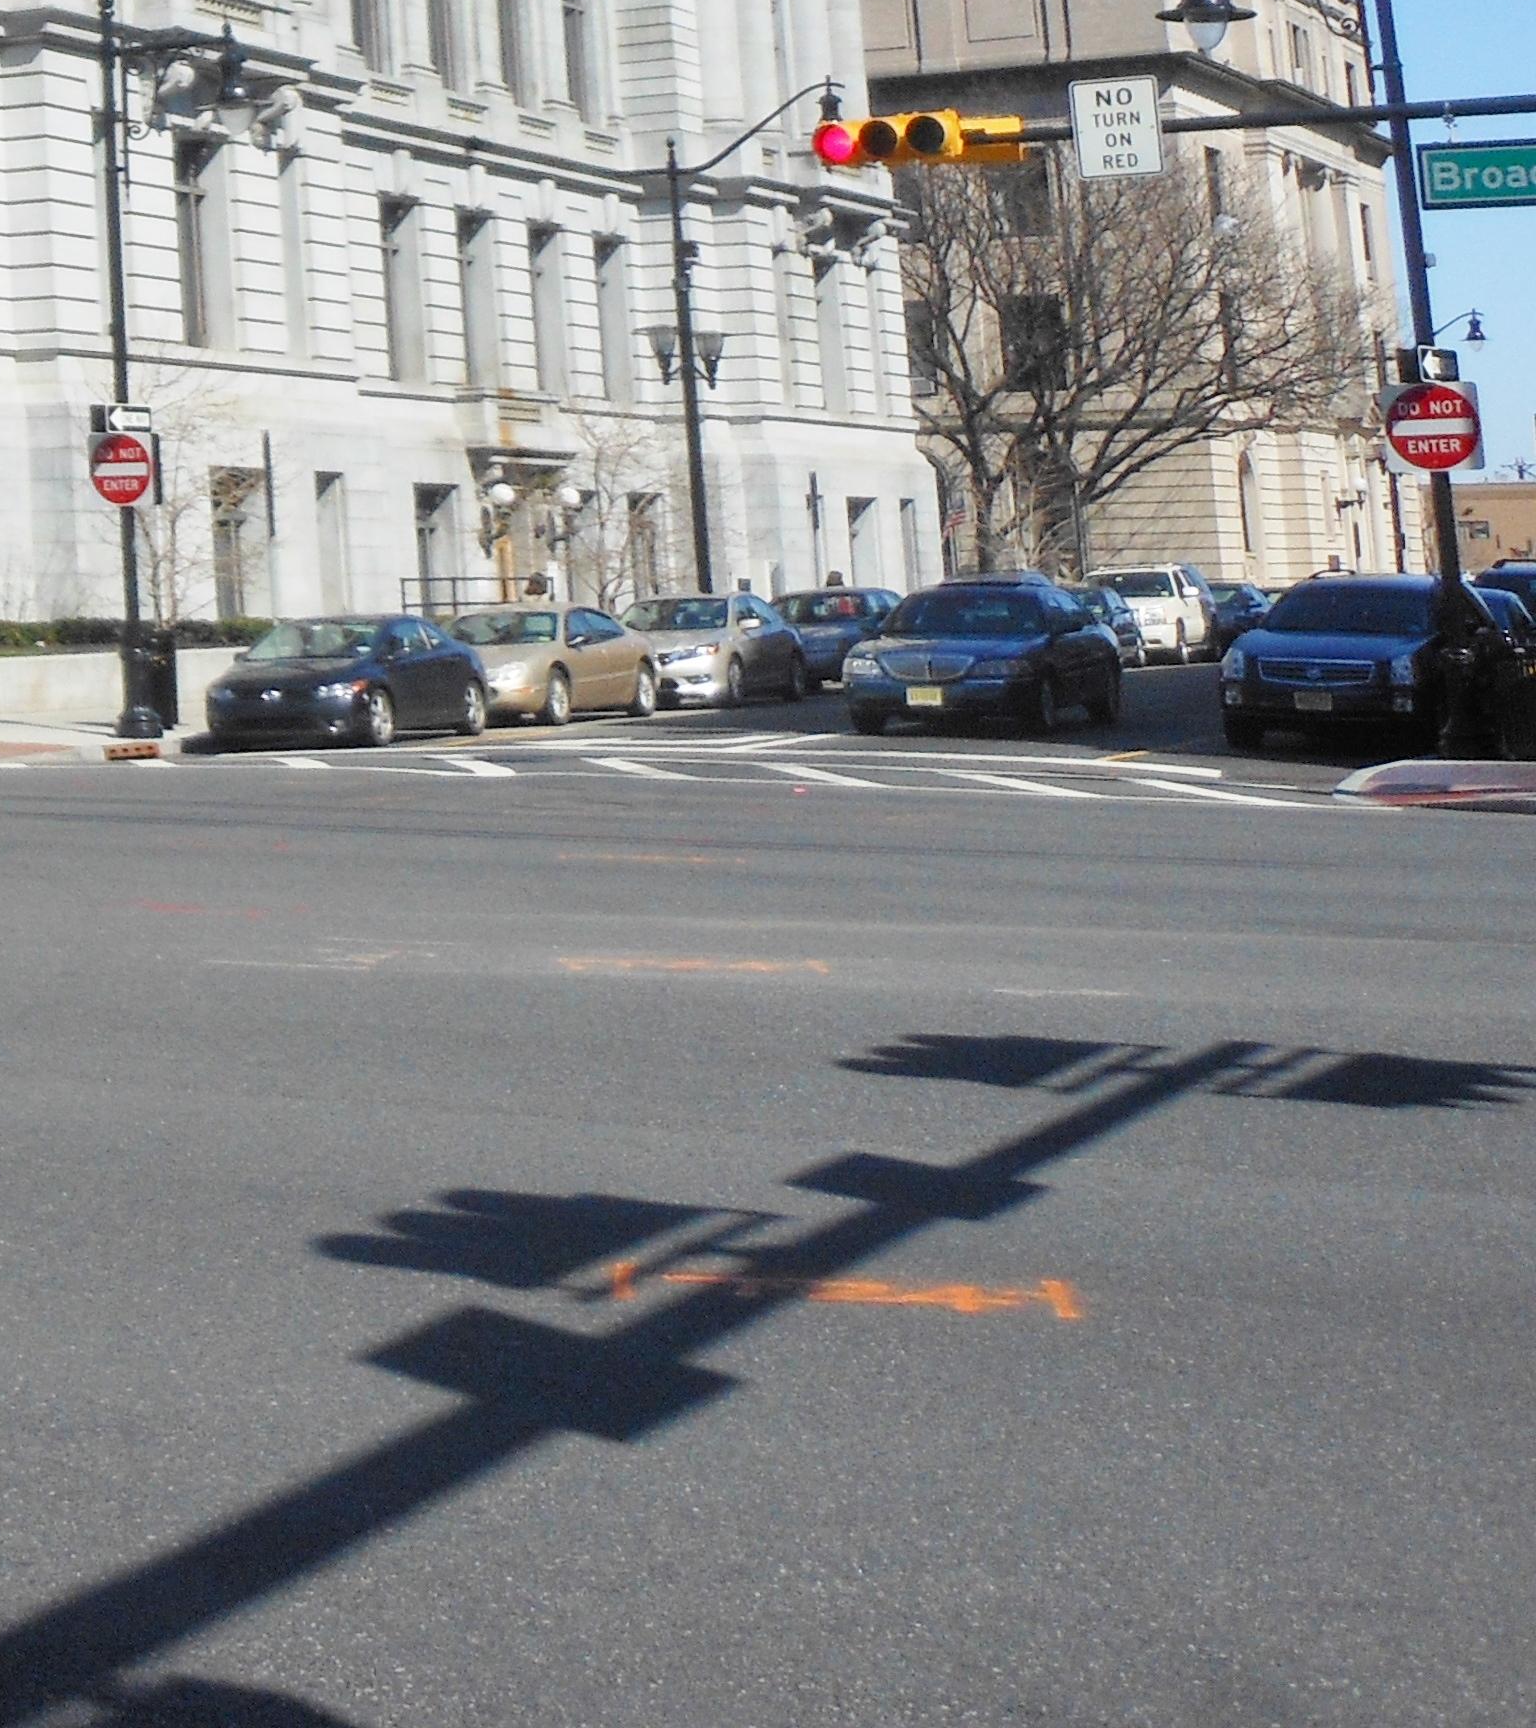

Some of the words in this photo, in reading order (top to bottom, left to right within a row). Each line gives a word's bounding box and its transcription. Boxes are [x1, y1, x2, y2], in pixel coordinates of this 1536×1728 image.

[1095, 88, 1133, 107] NO
[1092, 111, 1141, 128] TURN
[1105, 132, 1132, 148] ON
[1102, 153, 1138, 169] RED
[1398, 402, 1420, 416] DO
[1429, 399, 1463, 415] NOT
[119, 447, 143, 459] NOT
[1407, 438, 1461, 454] ENTER
[103, 479, 138, 491] ENTER
